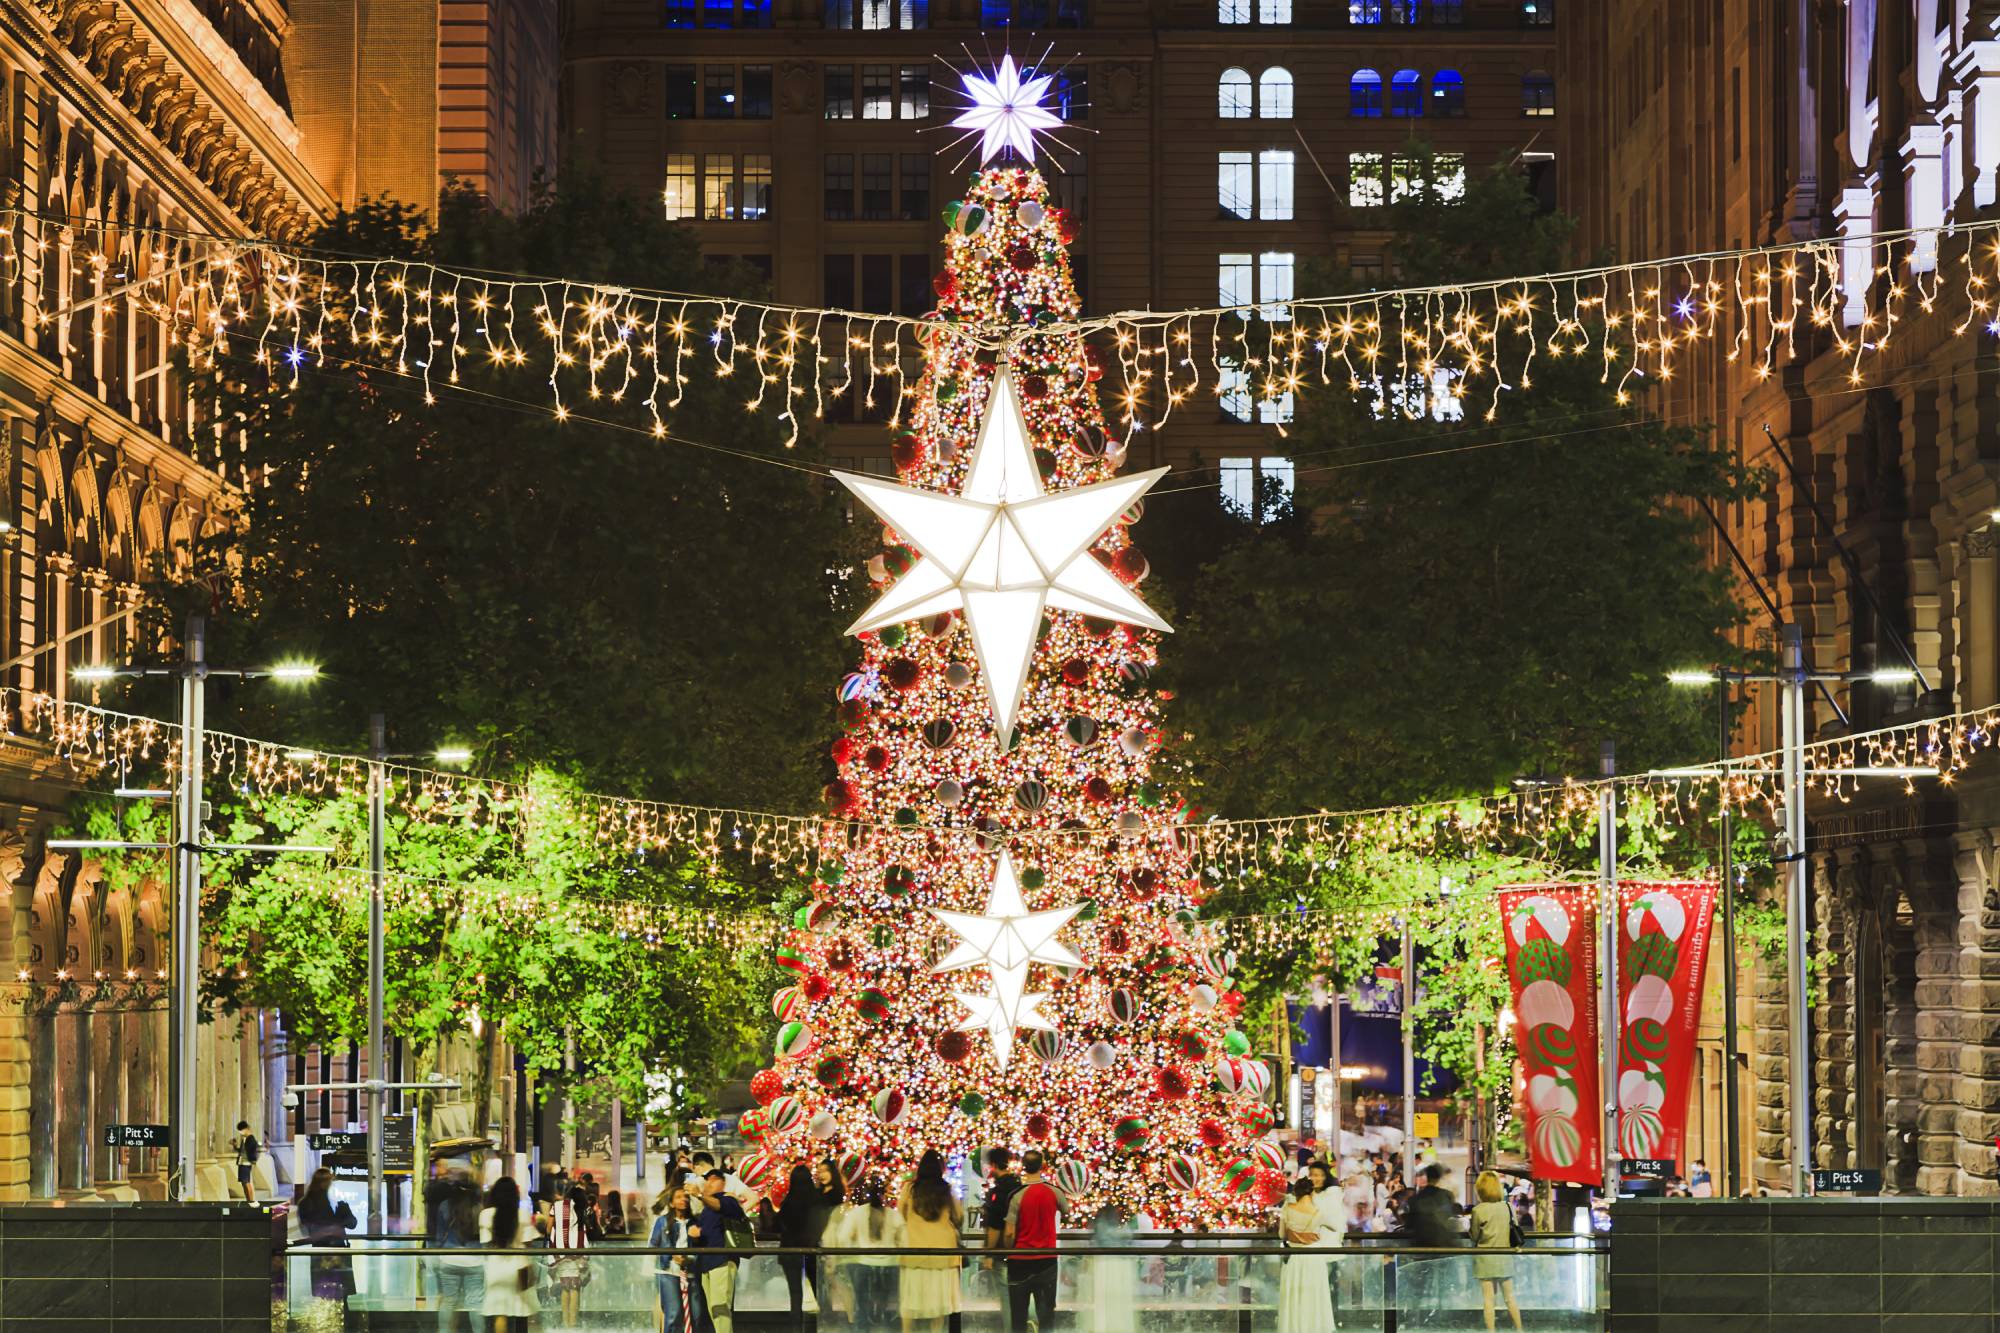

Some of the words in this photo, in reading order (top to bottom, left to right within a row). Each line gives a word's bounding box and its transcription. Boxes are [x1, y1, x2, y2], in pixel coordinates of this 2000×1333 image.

[125, 1127, 141, 1138] Pitt
[143, 1127, 154, 1139] St
[325, 1135, 341, 1144] Pitt
[342, 1135, 351, 1144] St
[1635, 1160, 1651, 1170] Pitt
[1651, 1160, 1661, 1170] St
[1832, 1172, 1851, 1184] Pitt
[1853, 1172, 1863, 1184] St
